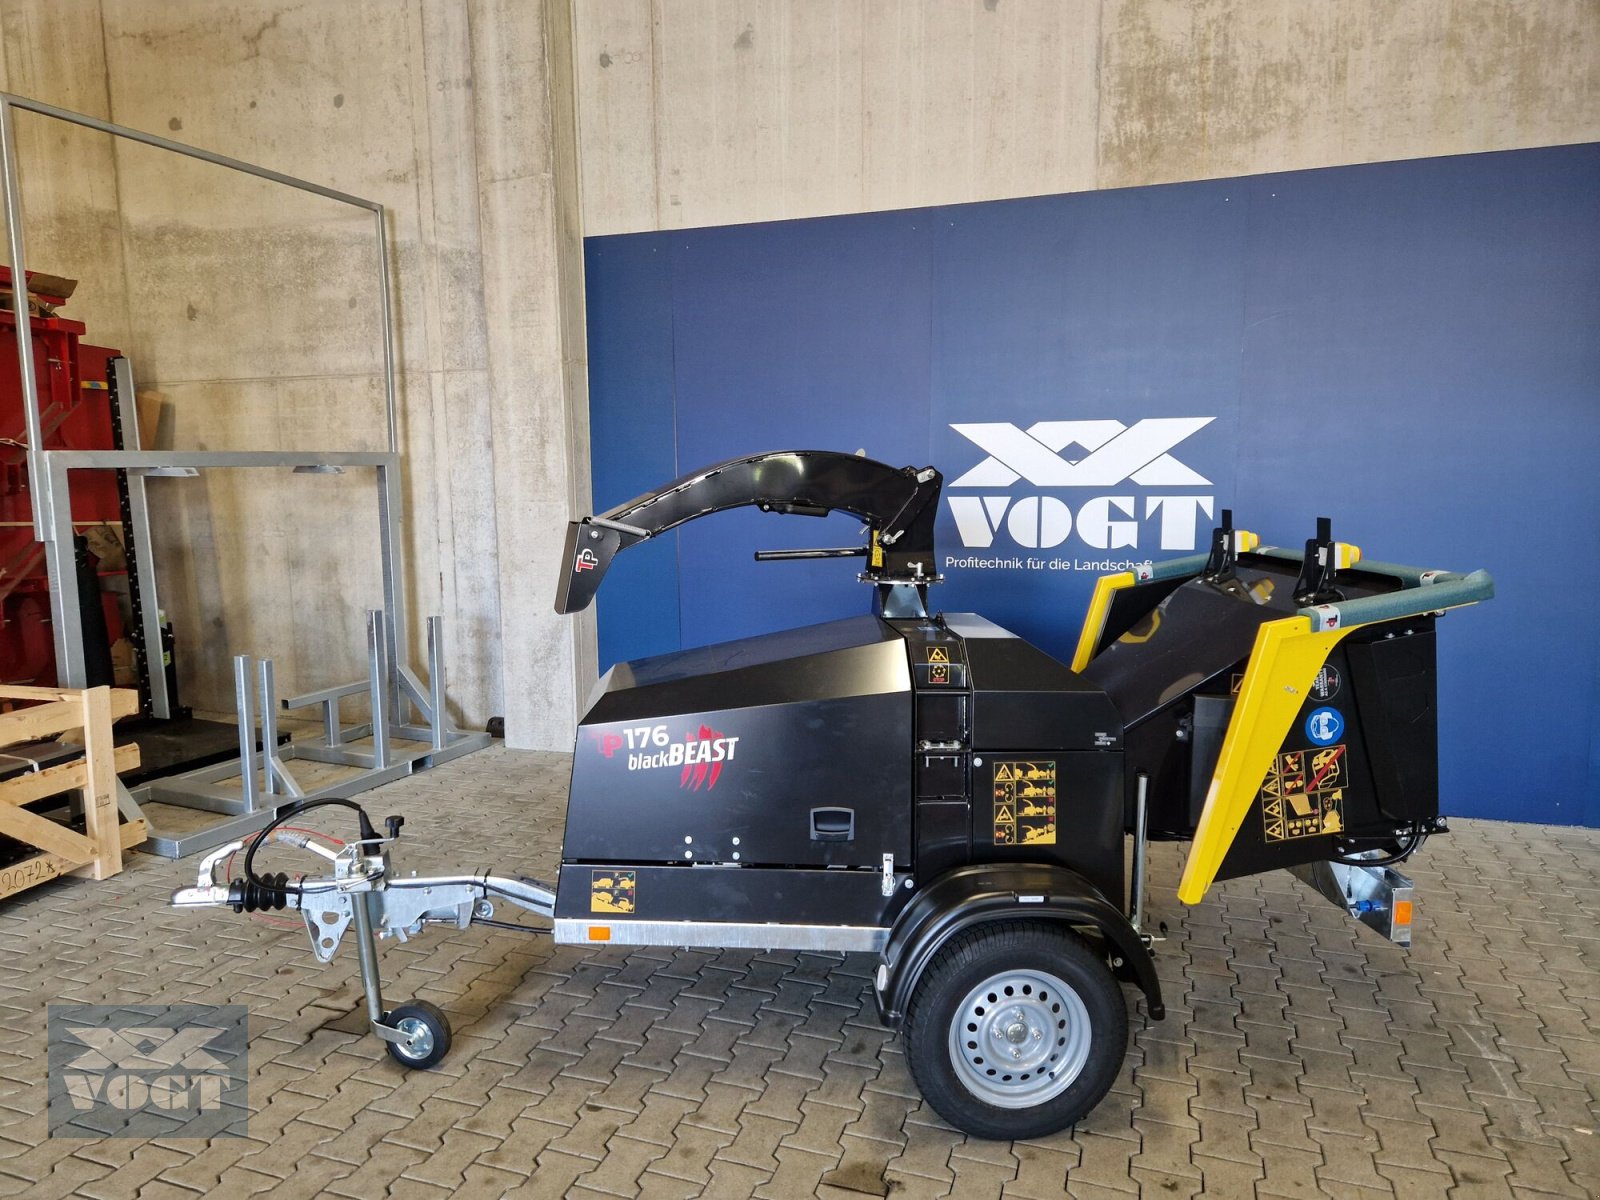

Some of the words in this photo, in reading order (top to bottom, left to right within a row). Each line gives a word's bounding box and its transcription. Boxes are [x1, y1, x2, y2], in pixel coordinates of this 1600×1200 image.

[947, 495, 1214, 550] VOGT
[575, 548, 598, 573] TP
[945, 556, 1023, 569] Profitechnik
[1027, 557, 1046, 570] für
[1048, 558, 1071, 570] die
[624, 725, 670, 749] 176
[628, 737, 739, 770] blackBEAST
